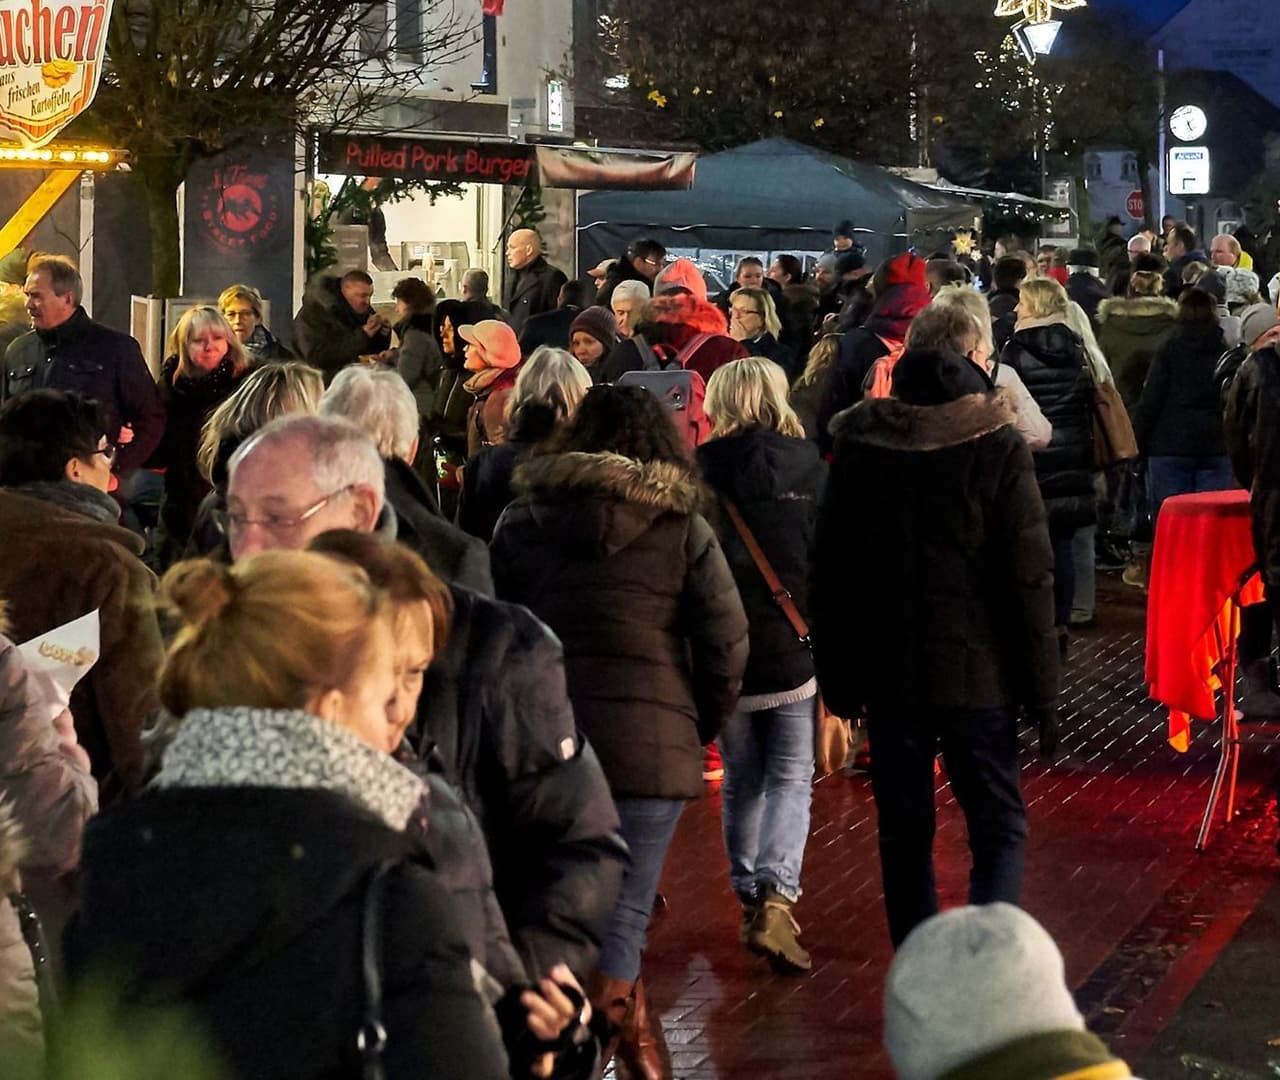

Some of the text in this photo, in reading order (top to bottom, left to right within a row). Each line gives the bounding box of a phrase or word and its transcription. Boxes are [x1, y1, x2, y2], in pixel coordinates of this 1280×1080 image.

[7, 81, 40, 109] frischen
[31, 88, 70, 116] Kartoffeln
[346, 143, 535, 183] Pulled Pork Burger
[1127, 199, 1143, 211] STO
